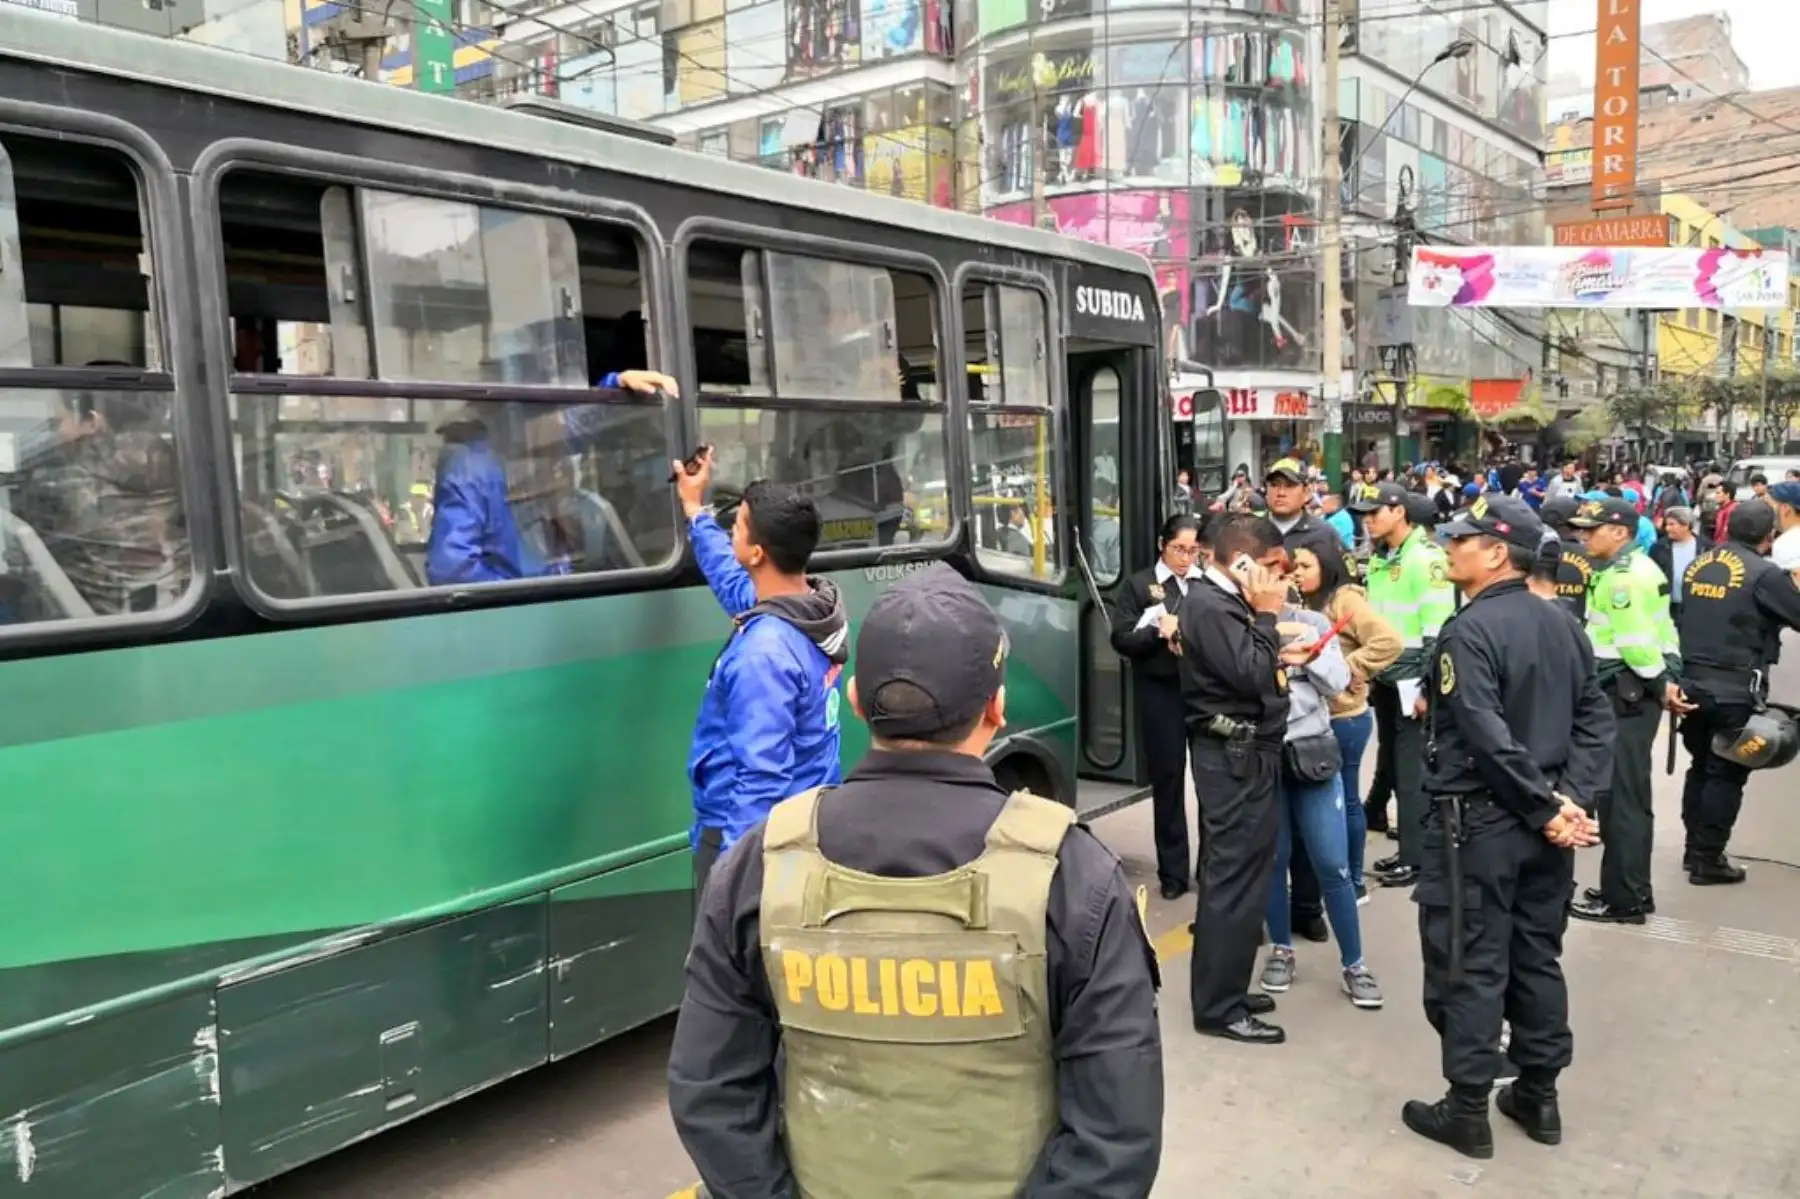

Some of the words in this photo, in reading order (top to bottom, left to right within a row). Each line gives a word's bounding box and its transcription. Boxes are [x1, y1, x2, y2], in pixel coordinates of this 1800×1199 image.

[424, 0, 448, 84] AT
[1605, 0, 1629, 45] LA
[1603, 66, 1629, 203] TORRE
[1557, 226, 1577, 245] DE
[1581, 218, 1665, 242] GAMARRA
[1075, 284, 1145, 322] SUBIDA
[782, 949, 1004, 1017] POLICIA
